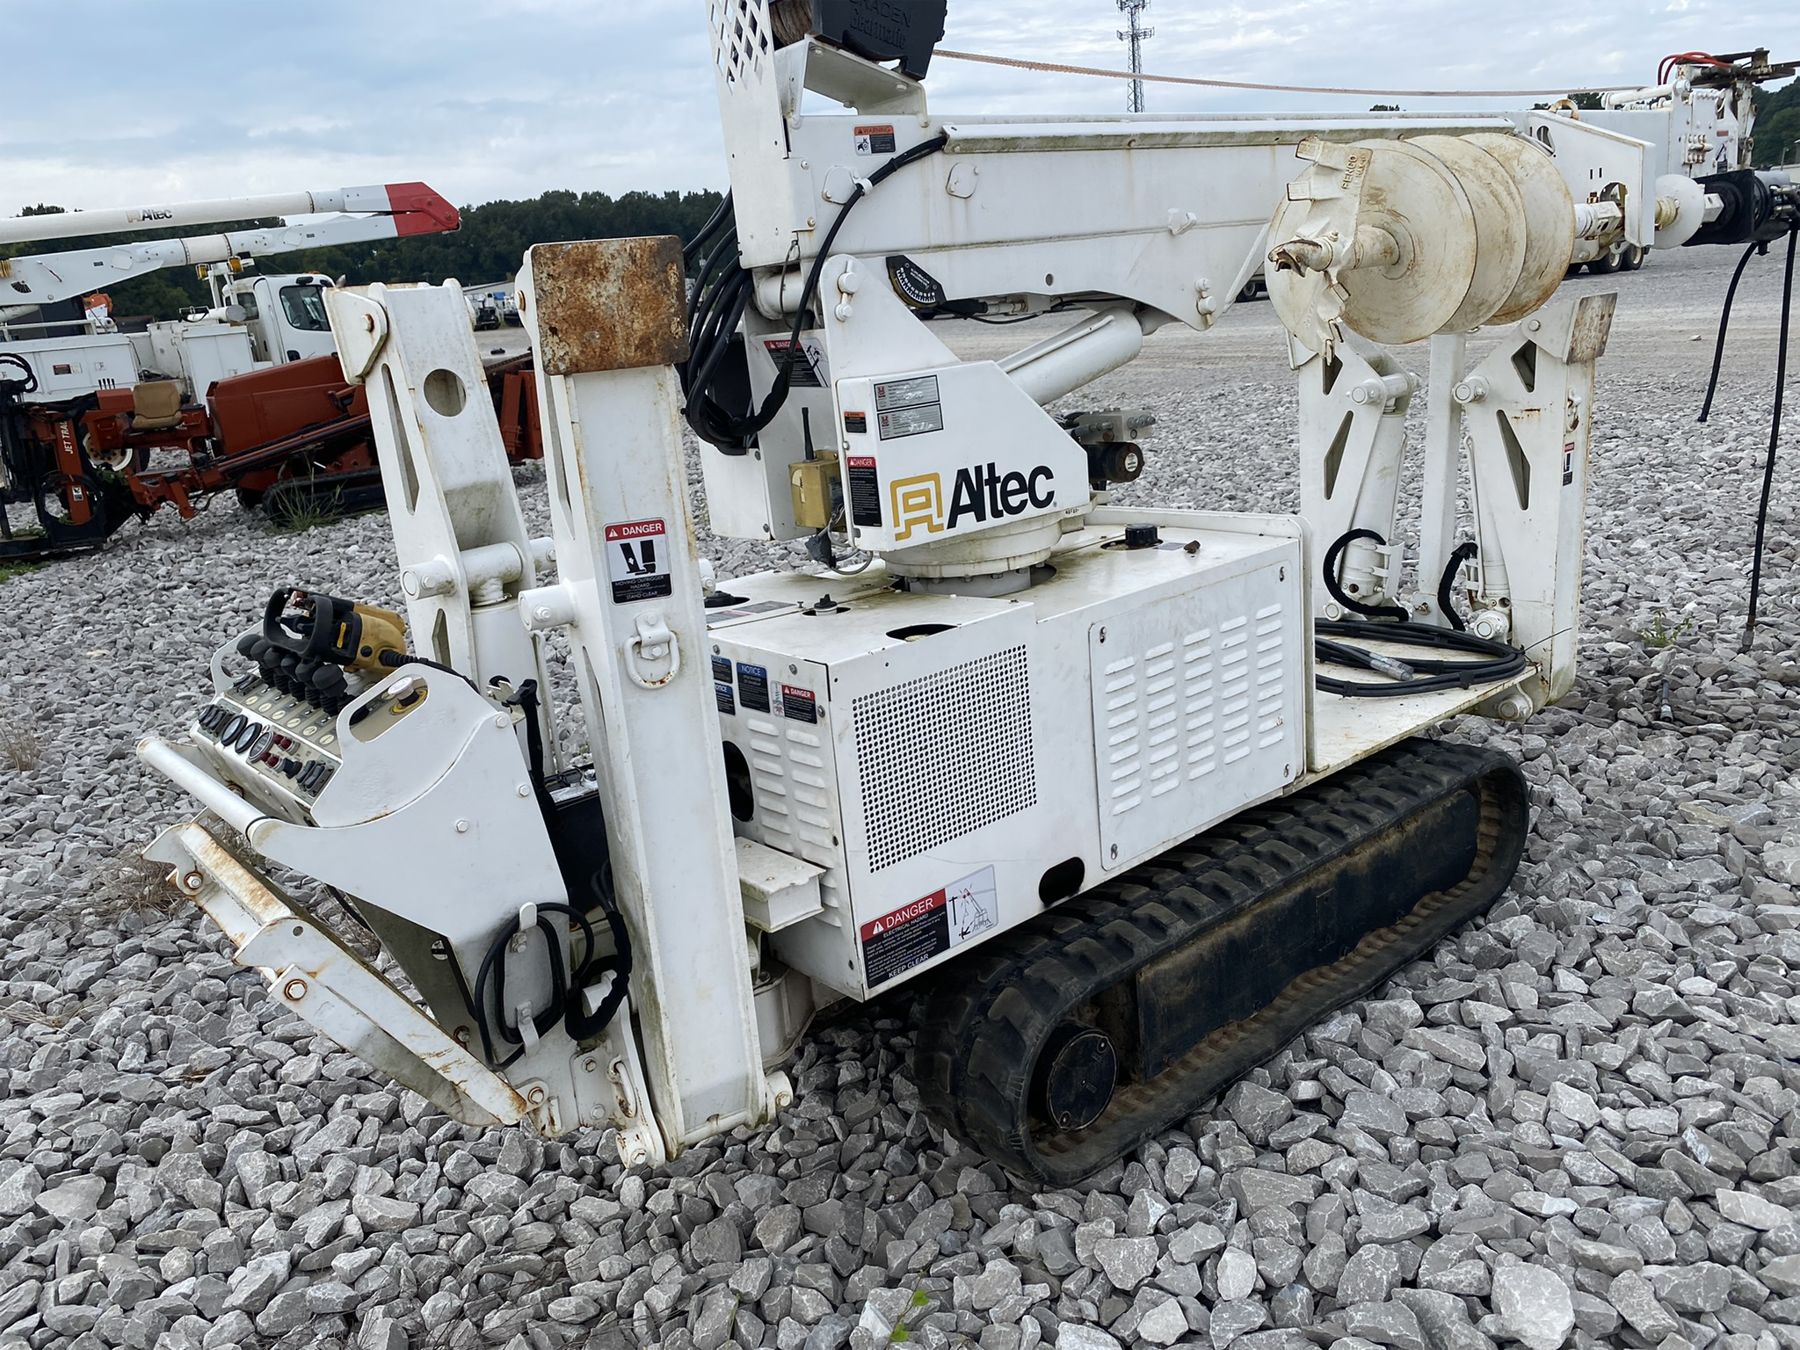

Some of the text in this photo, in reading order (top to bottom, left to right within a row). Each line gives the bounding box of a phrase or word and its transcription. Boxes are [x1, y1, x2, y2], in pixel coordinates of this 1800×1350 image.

[848, 0, 912, 28] RADEN
[142, 208, 173, 221] Altec
[64, 441, 74, 454] JET
[946, 462, 1055, 530] Altec
[622, 523, 662, 536] DANGER
[741, 665, 761, 675] NOTICE
[790, 687, 811, 698] DANGER
[886, 897, 934, 928] DANGER
[883, 913, 928, 938] ELECTRICAL HAZARD
[888, 953, 929, 978] KEEP CLEAR
